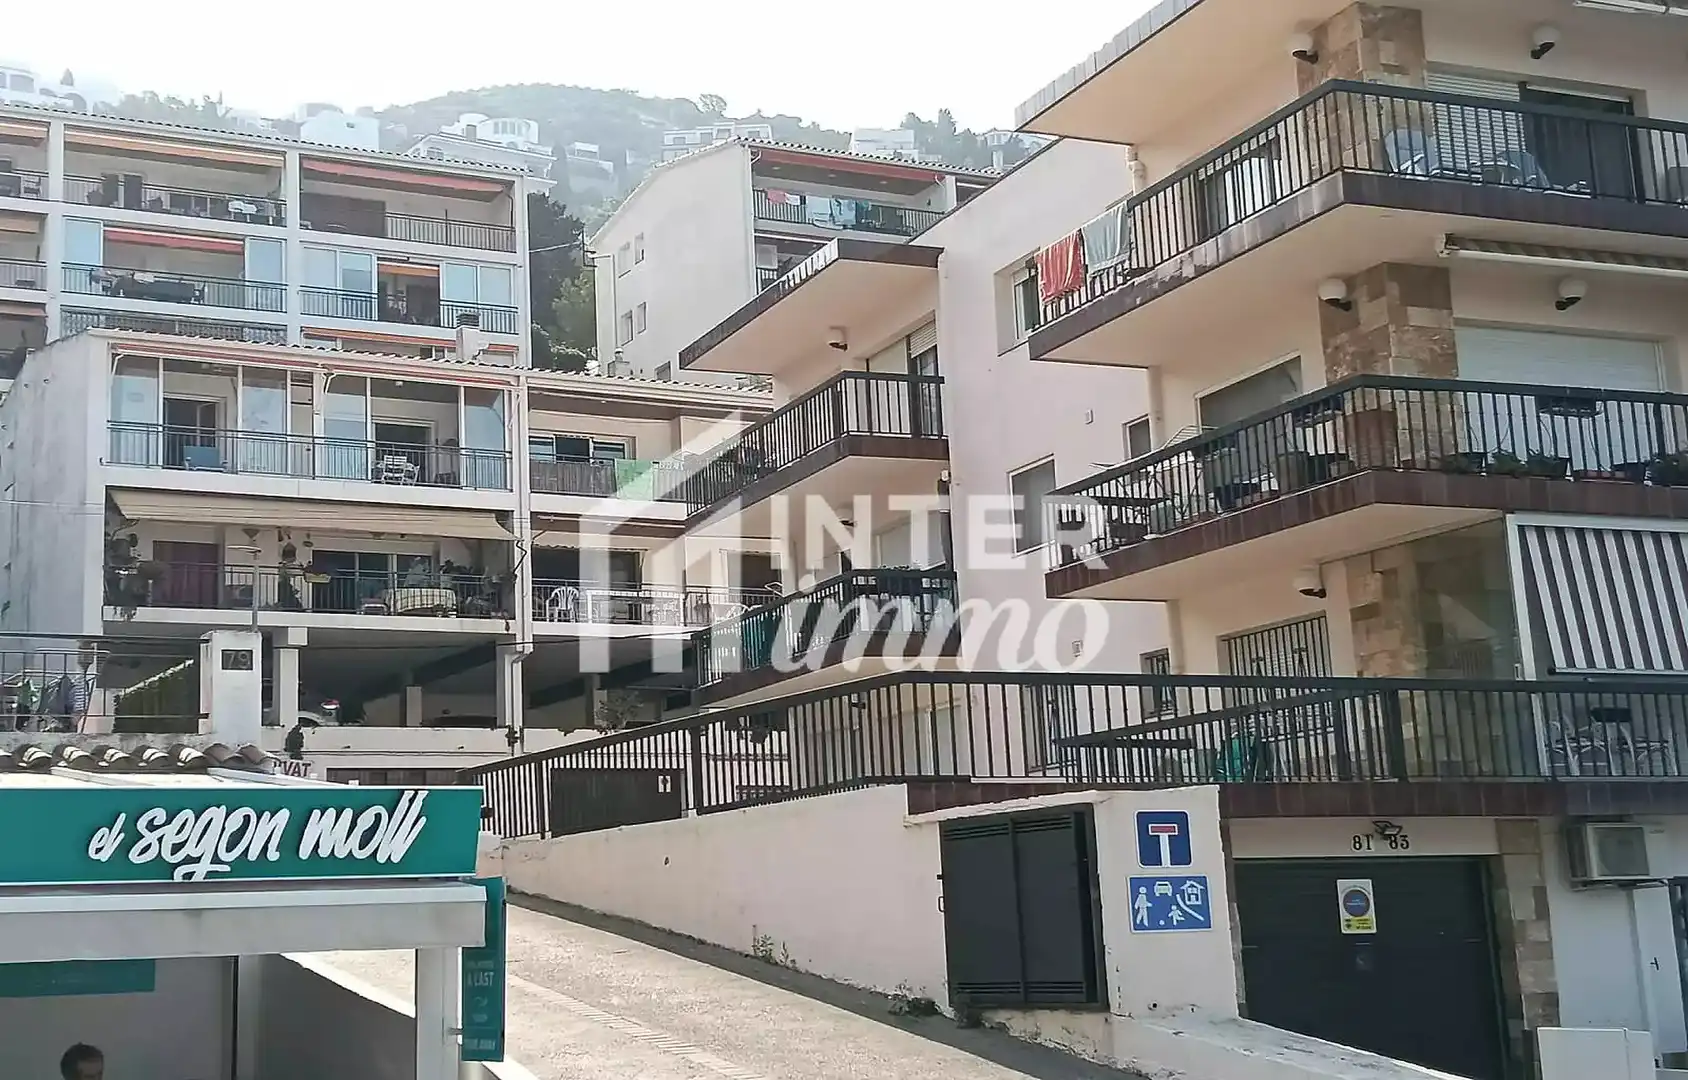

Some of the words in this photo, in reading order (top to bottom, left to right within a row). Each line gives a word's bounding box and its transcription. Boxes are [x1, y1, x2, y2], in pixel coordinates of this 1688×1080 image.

[223, 650, 250, 669] 79
[88, 812, 126, 862] el
[128, 804, 290, 880] segon
[298, 790, 429, 864] moll
[1388, 834, 1410, 850] 83
